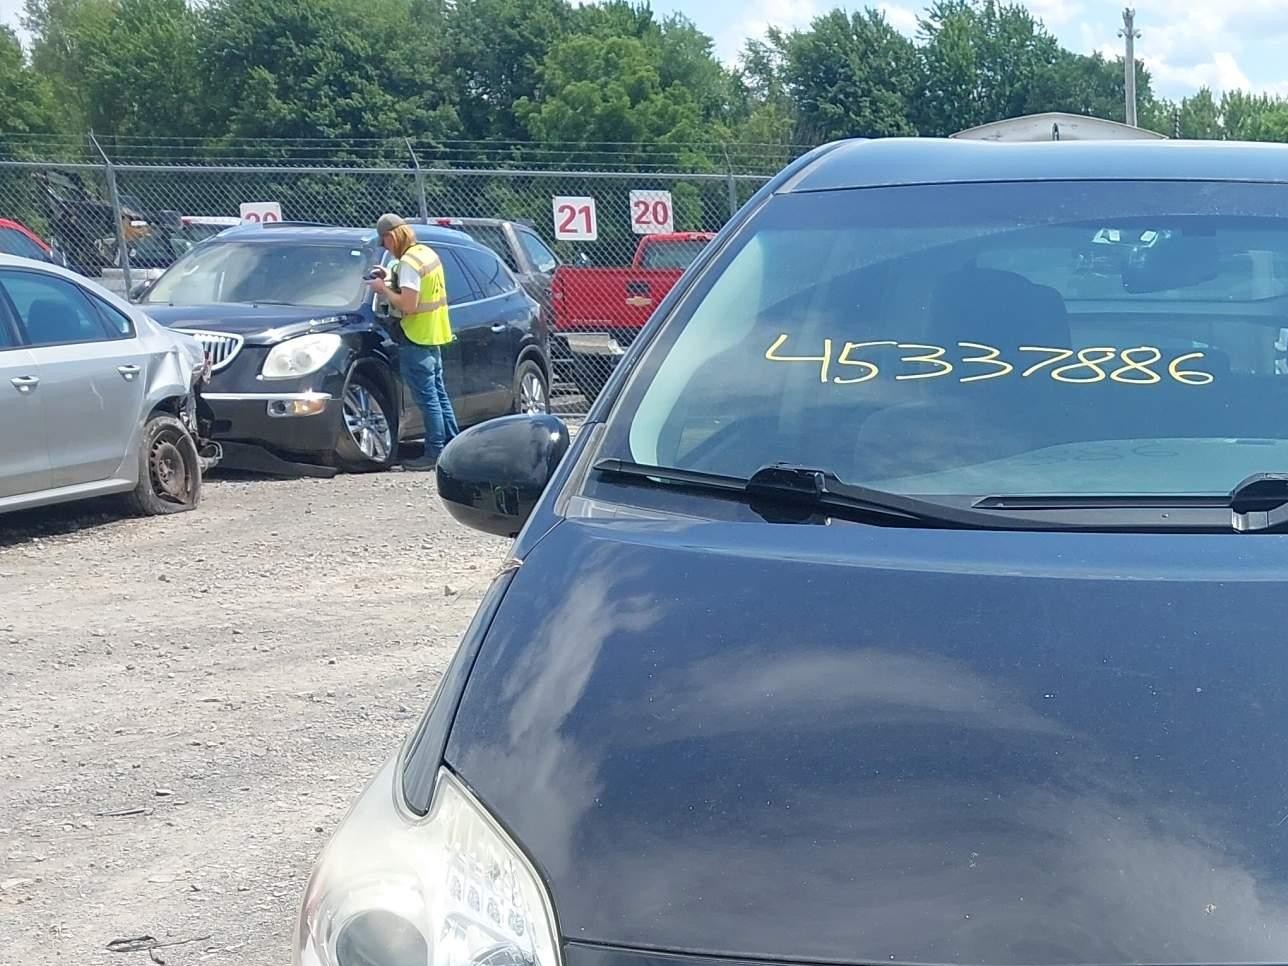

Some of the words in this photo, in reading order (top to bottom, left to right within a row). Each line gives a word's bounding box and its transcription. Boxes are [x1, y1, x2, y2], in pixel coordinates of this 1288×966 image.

[558, 204, 593, 234] 21
[633, 200, 669, 226] 20
[764, 333, 1215, 385] 45337886
